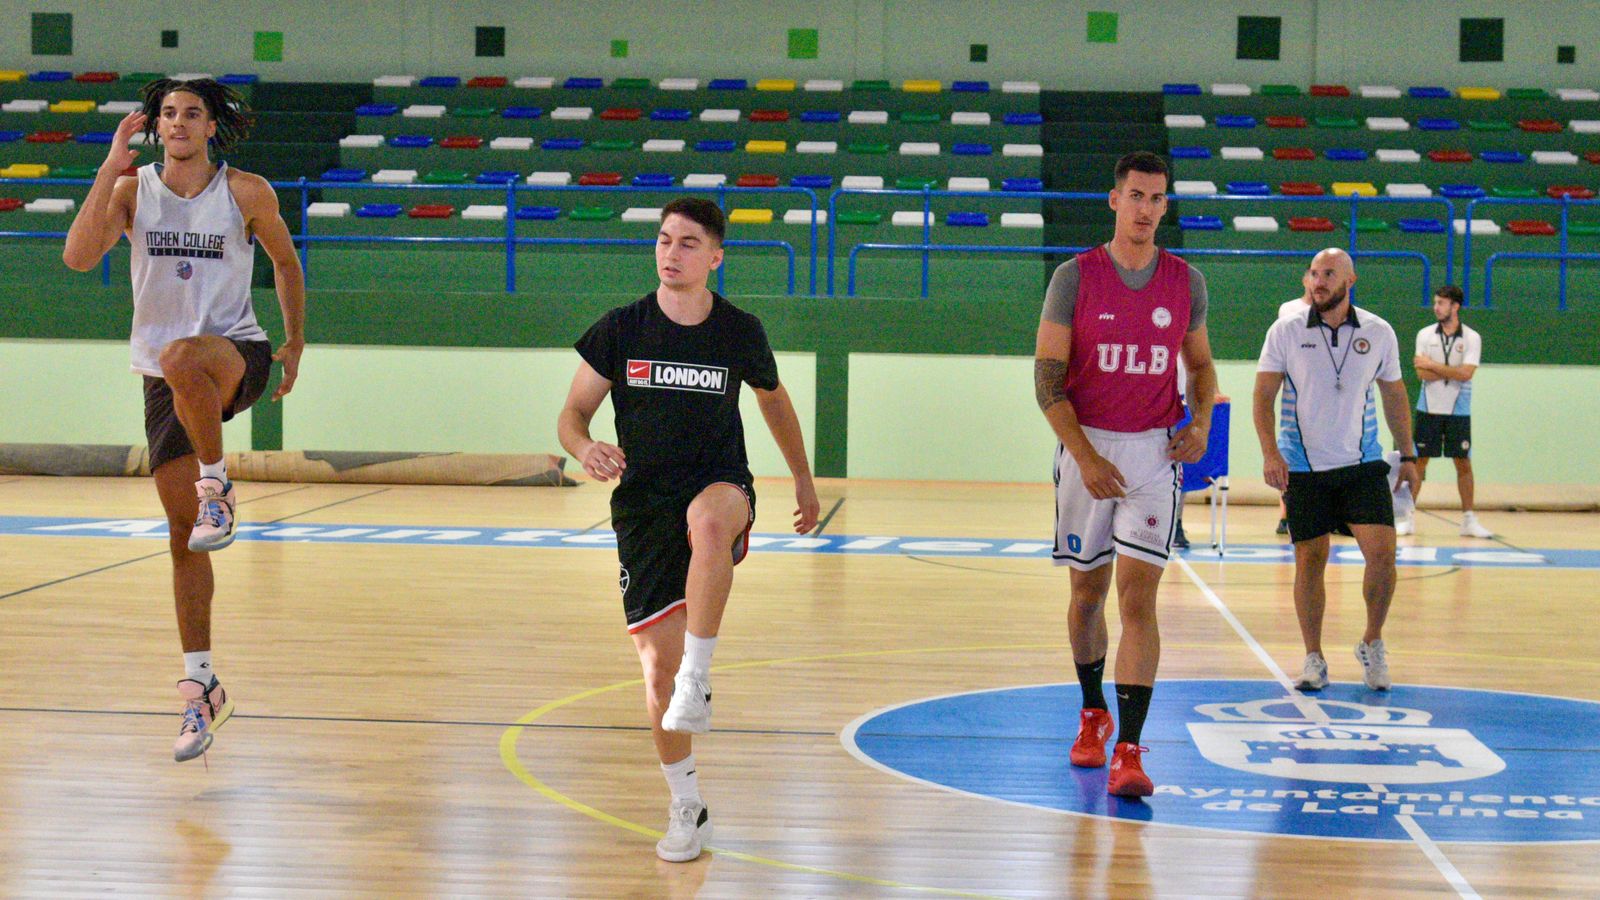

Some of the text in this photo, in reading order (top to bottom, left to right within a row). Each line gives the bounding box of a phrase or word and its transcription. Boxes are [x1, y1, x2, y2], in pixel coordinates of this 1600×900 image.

[146, 231, 225, 250] ITCHEN COLLEGE
[1097, 344, 1169, 375] ULB
[655, 366, 722, 389] LONDON
[1202, 799, 1283, 812] de
[1301, 801, 1379, 815] La
